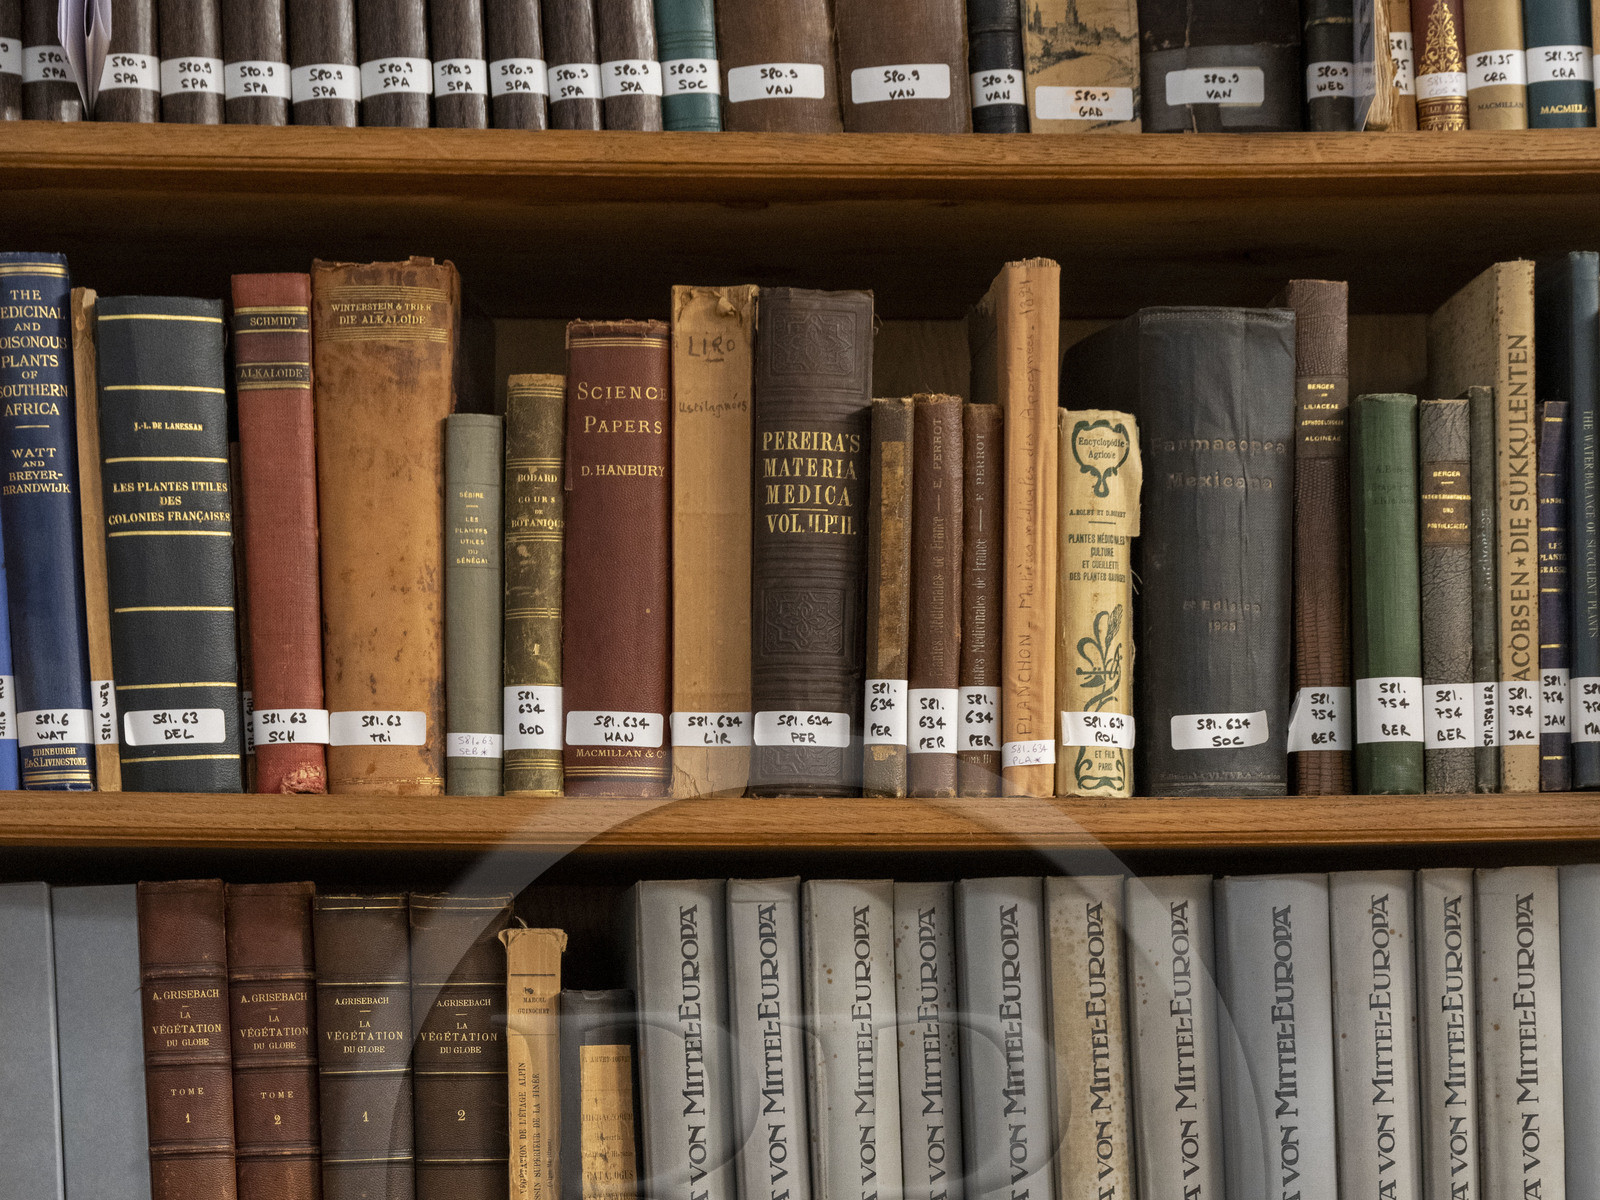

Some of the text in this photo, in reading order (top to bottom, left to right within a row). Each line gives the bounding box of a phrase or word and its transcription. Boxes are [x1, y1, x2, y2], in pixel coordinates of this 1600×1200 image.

[10, 289, 42, 300] THE
[0, 305, 66, 320] EDICINAL
[331, 302, 432, 313] WINTERSTEIN & TRIER
[250, 316, 297, 327] SCHMIDT
[339, 315, 358, 325] DIE
[14, 322, 41, 332] AND
[0, 335, 68, 350] OISONOUS
[689, 336, 735, 357] LIRO
[1, 354, 59, 368] PLANTS
[21, 370, 38, 380] OF
[240, 368, 303, 379] ALKALOIDE
[0, 383, 68, 398] SOUTHERN
[577, 382, 667, 401] SCIENCE
[4, 402, 60, 417] AFRICA
[152, 422, 203, 431] DE LANESSAN
[584, 416, 663, 435] PAPERS
[762, 431, 860, 453] PEREIRA'S
[933, 418, 943, 469] PERROT
[11, 448, 57, 459] WATT
[581, 464, 666, 478] D. HANBURY
[762, 457, 857, 480] MATERIA
[8, 470, 64, 482] BREYER-
[517, 473, 558, 484] BODARD
[1166, 471, 1273, 489] Mexicana
[2, 482, 71, 496] BRANDWIJK
[113, 481, 228, 493] LES PLANTES UTILES
[159, 495, 182, 506] DES
[518, 495, 556, 504] COURS
[765, 484, 853, 506] MEDICA
[1508, 335, 1530, 682] ACOBSEN DIE SUKKULENTEN
[108, 511, 231, 525] COLONIES FRANÇAISES
[766, 514, 806, 534] VOL.
[1588, 600, 1598, 638] PLANTS
[519, 704, 545, 714] 634
[1311, 709, 1336, 721] 754
[35, 713, 69, 725] 581.6
[153, 712, 199, 724] 581.63
[262, 713, 307, 724] 581.63
[594, 716, 649, 728] 581.634
[1197, 718, 1251, 730] 581.634
[164, 730, 194, 740] DEL
[519, 723, 545, 735] BOD
[37, 731, 67, 740] WAT
[269, 731, 295, 742] SCH
[604, 732, 634, 742] HAN
[1212, 736, 1244, 747] SOC
[1311, 732, 1336, 744] BER
[1508, 730, 1535, 741] JAC
[32, 747, 77, 756] EDINBURGH
[576, 748, 642, 758] MACMILLAN
[163, 989, 219, 1000] GRISEBACH
[152, 1024, 222, 1035] VÉGÉTATION
[326, 1030, 403, 1041] VÉGÉTATION
[167, 1038, 209, 1047] DU GLOBE
[343, 1046, 385, 1055] DU GLOBE
[171, 1087, 204, 1096] TOME
[457, 1109, 466, 1121] 2
[1522, 1113, 1541, 1173] VON
[688, 1125, 707, 1185] VON
[1096, 1121, 1114, 1180] VON
[1280, 1125, 1299, 1187] VON
